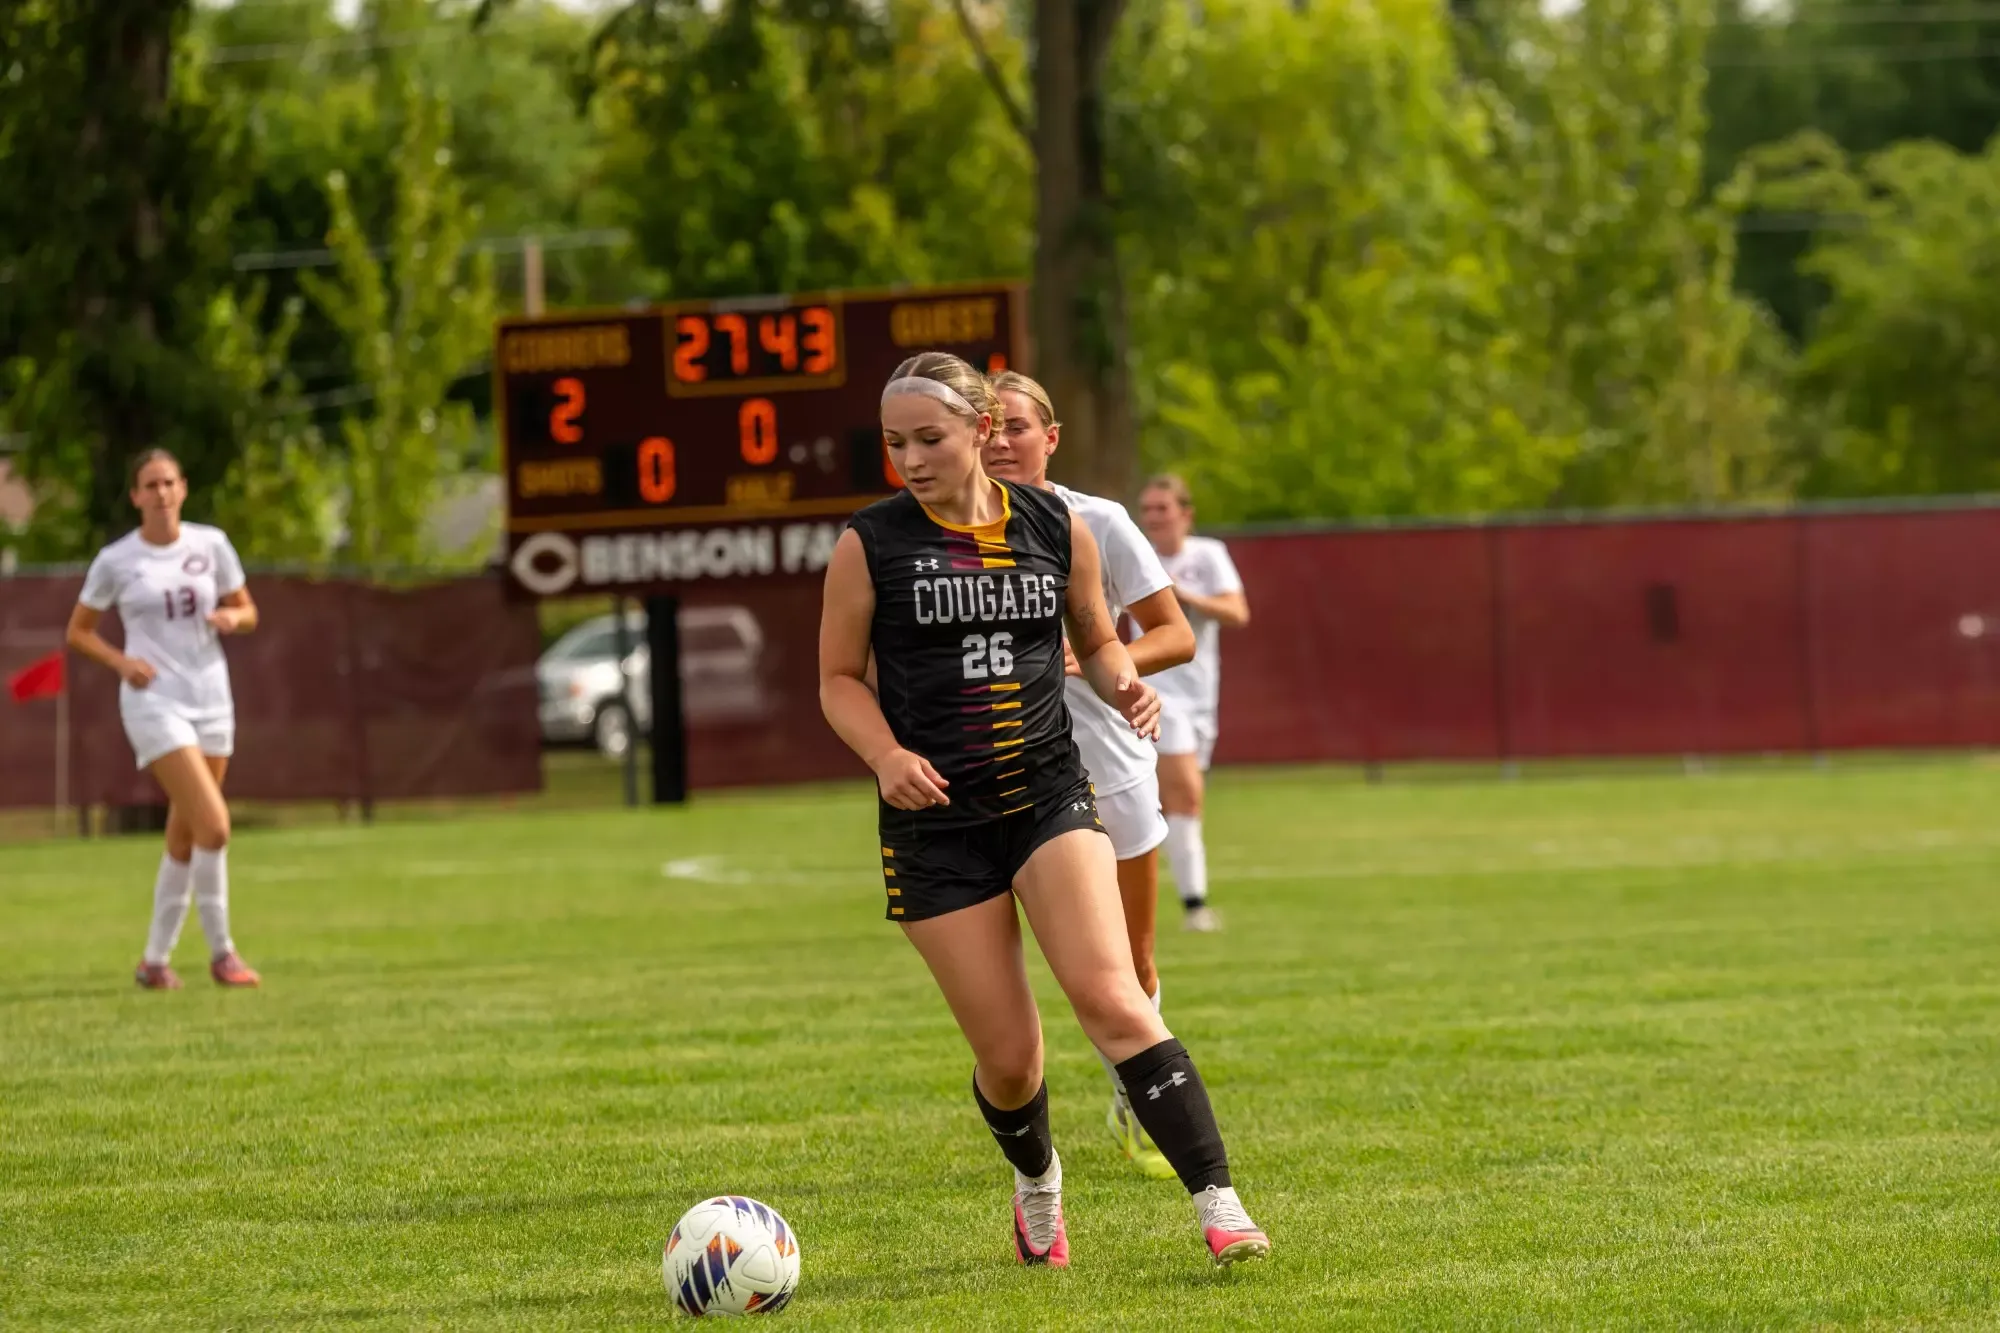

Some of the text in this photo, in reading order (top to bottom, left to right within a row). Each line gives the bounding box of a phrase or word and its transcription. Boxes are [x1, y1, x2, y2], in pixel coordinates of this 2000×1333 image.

[890, 297, 996, 348] GUEST
[549, 376, 585, 444] 2
[739, 397, 777, 465] 0
[636, 436, 676, 502] 0
[580, 523, 775, 586] BENSON
[781, 519, 848, 574] FA
[164, 586, 198, 621] 13
[913, 574, 1057, 625] COUGARS
[961, 631, 1014, 679] 26
